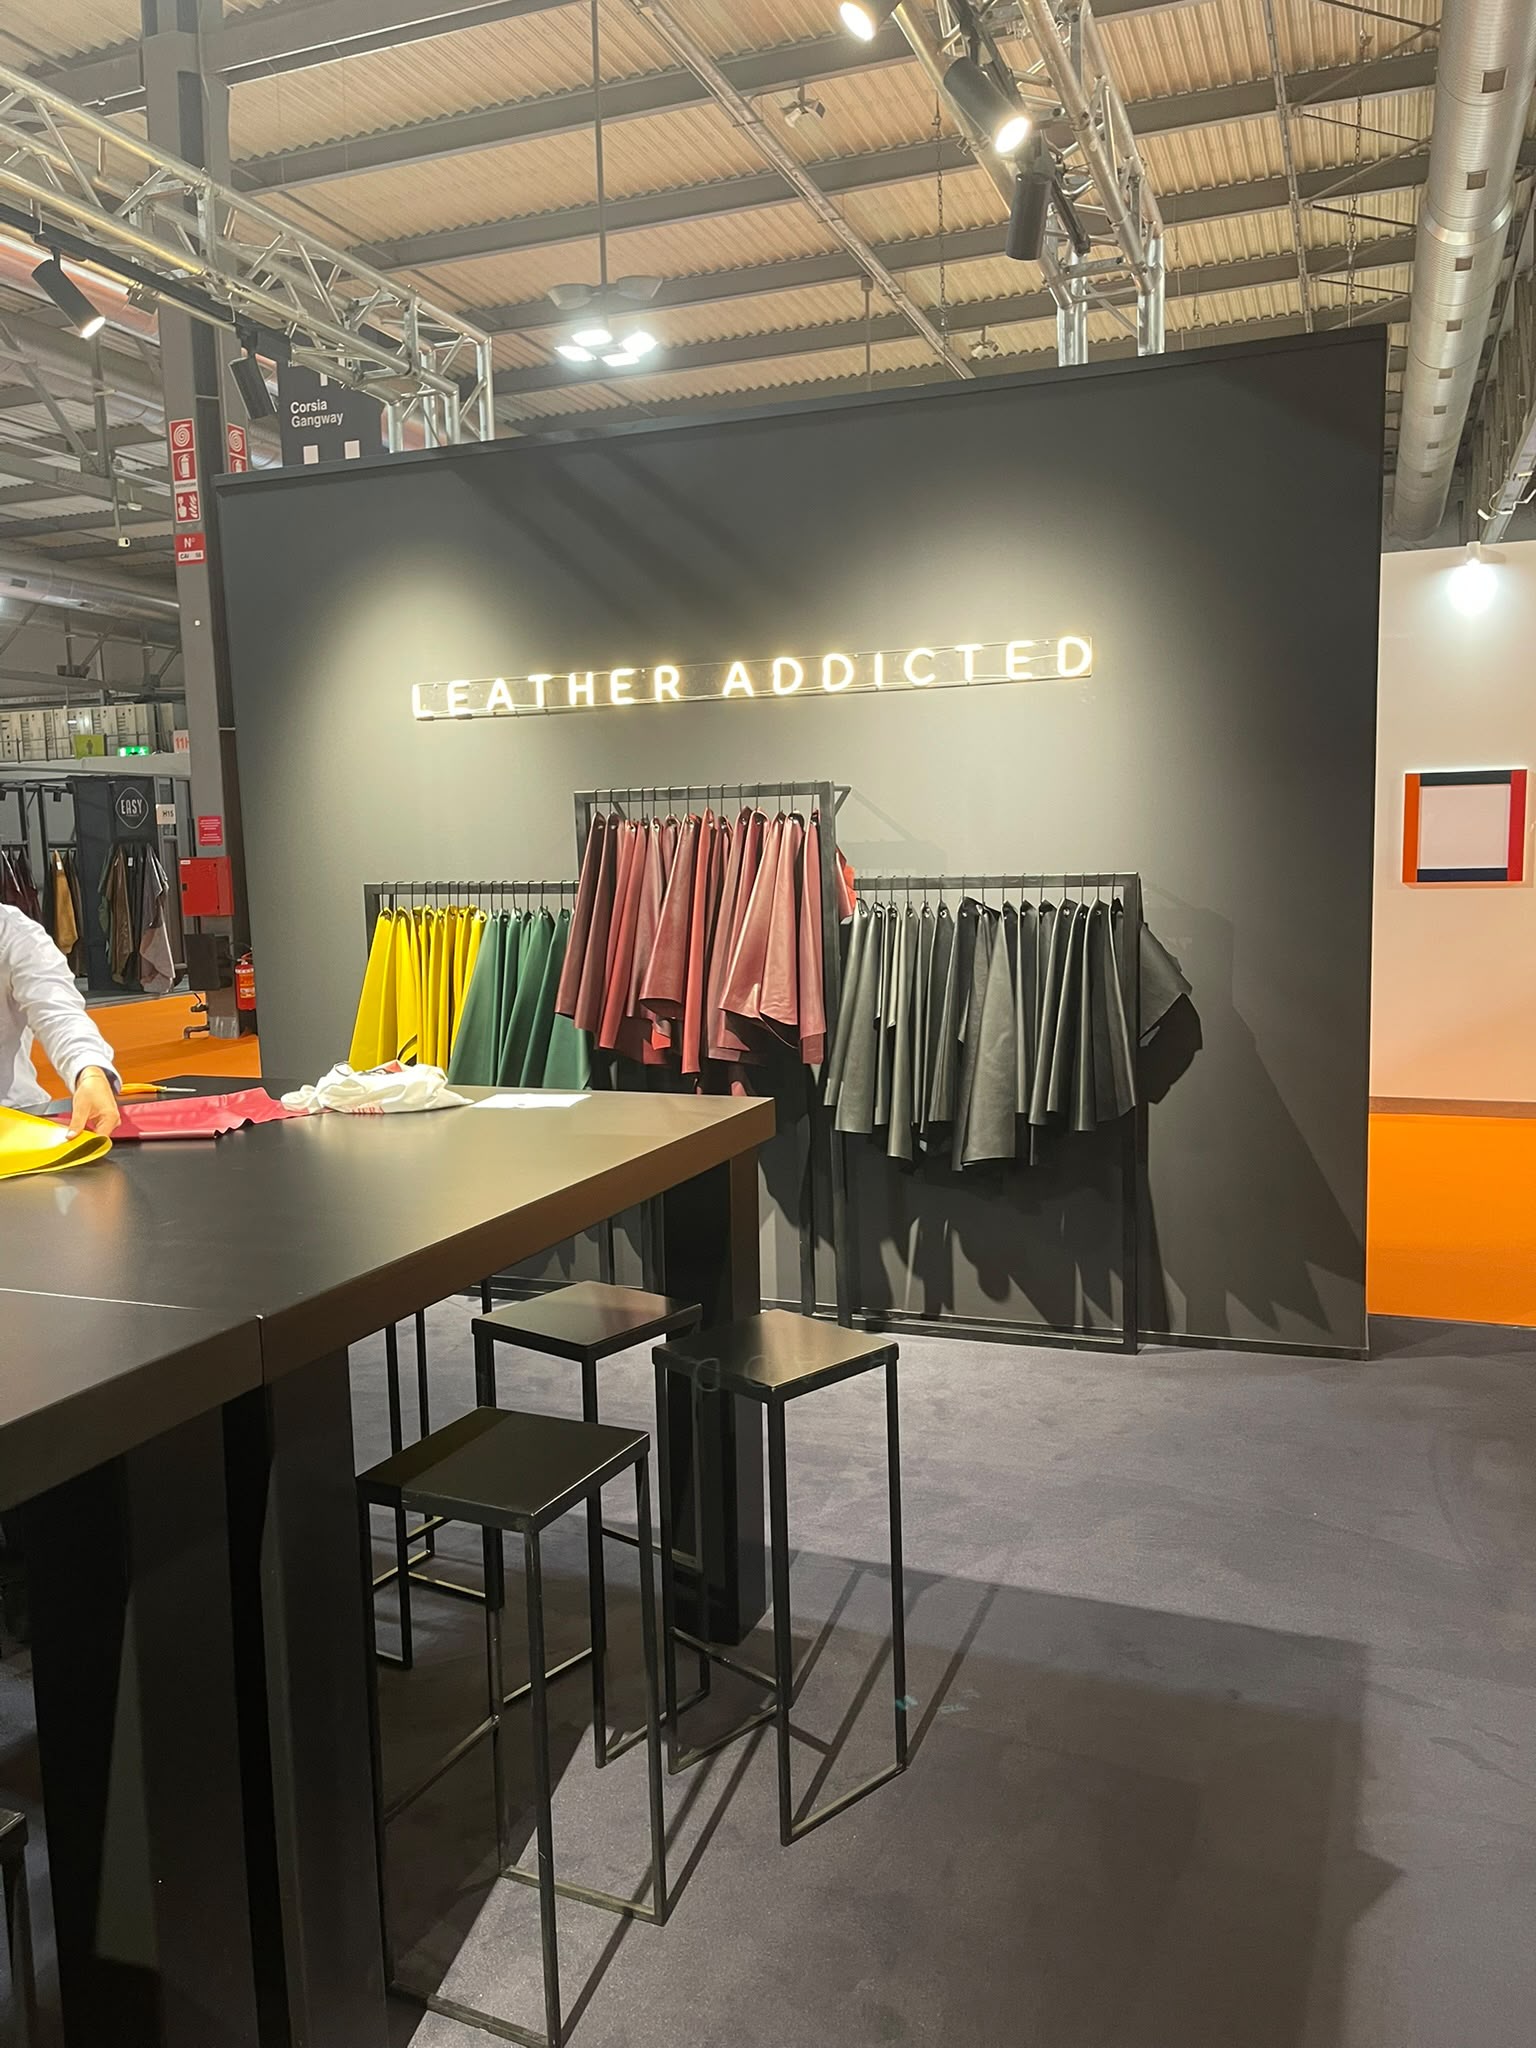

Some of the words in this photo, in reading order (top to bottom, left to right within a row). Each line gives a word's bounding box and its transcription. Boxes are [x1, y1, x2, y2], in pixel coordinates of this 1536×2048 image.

[290, 399, 328, 414] Corsia
[291, 413, 344, 428] Gangway
[412, 665, 681, 718] LEATHER
[722, 636, 1092, 698] ADDICTED
[120, 799, 143, 815] EASY
